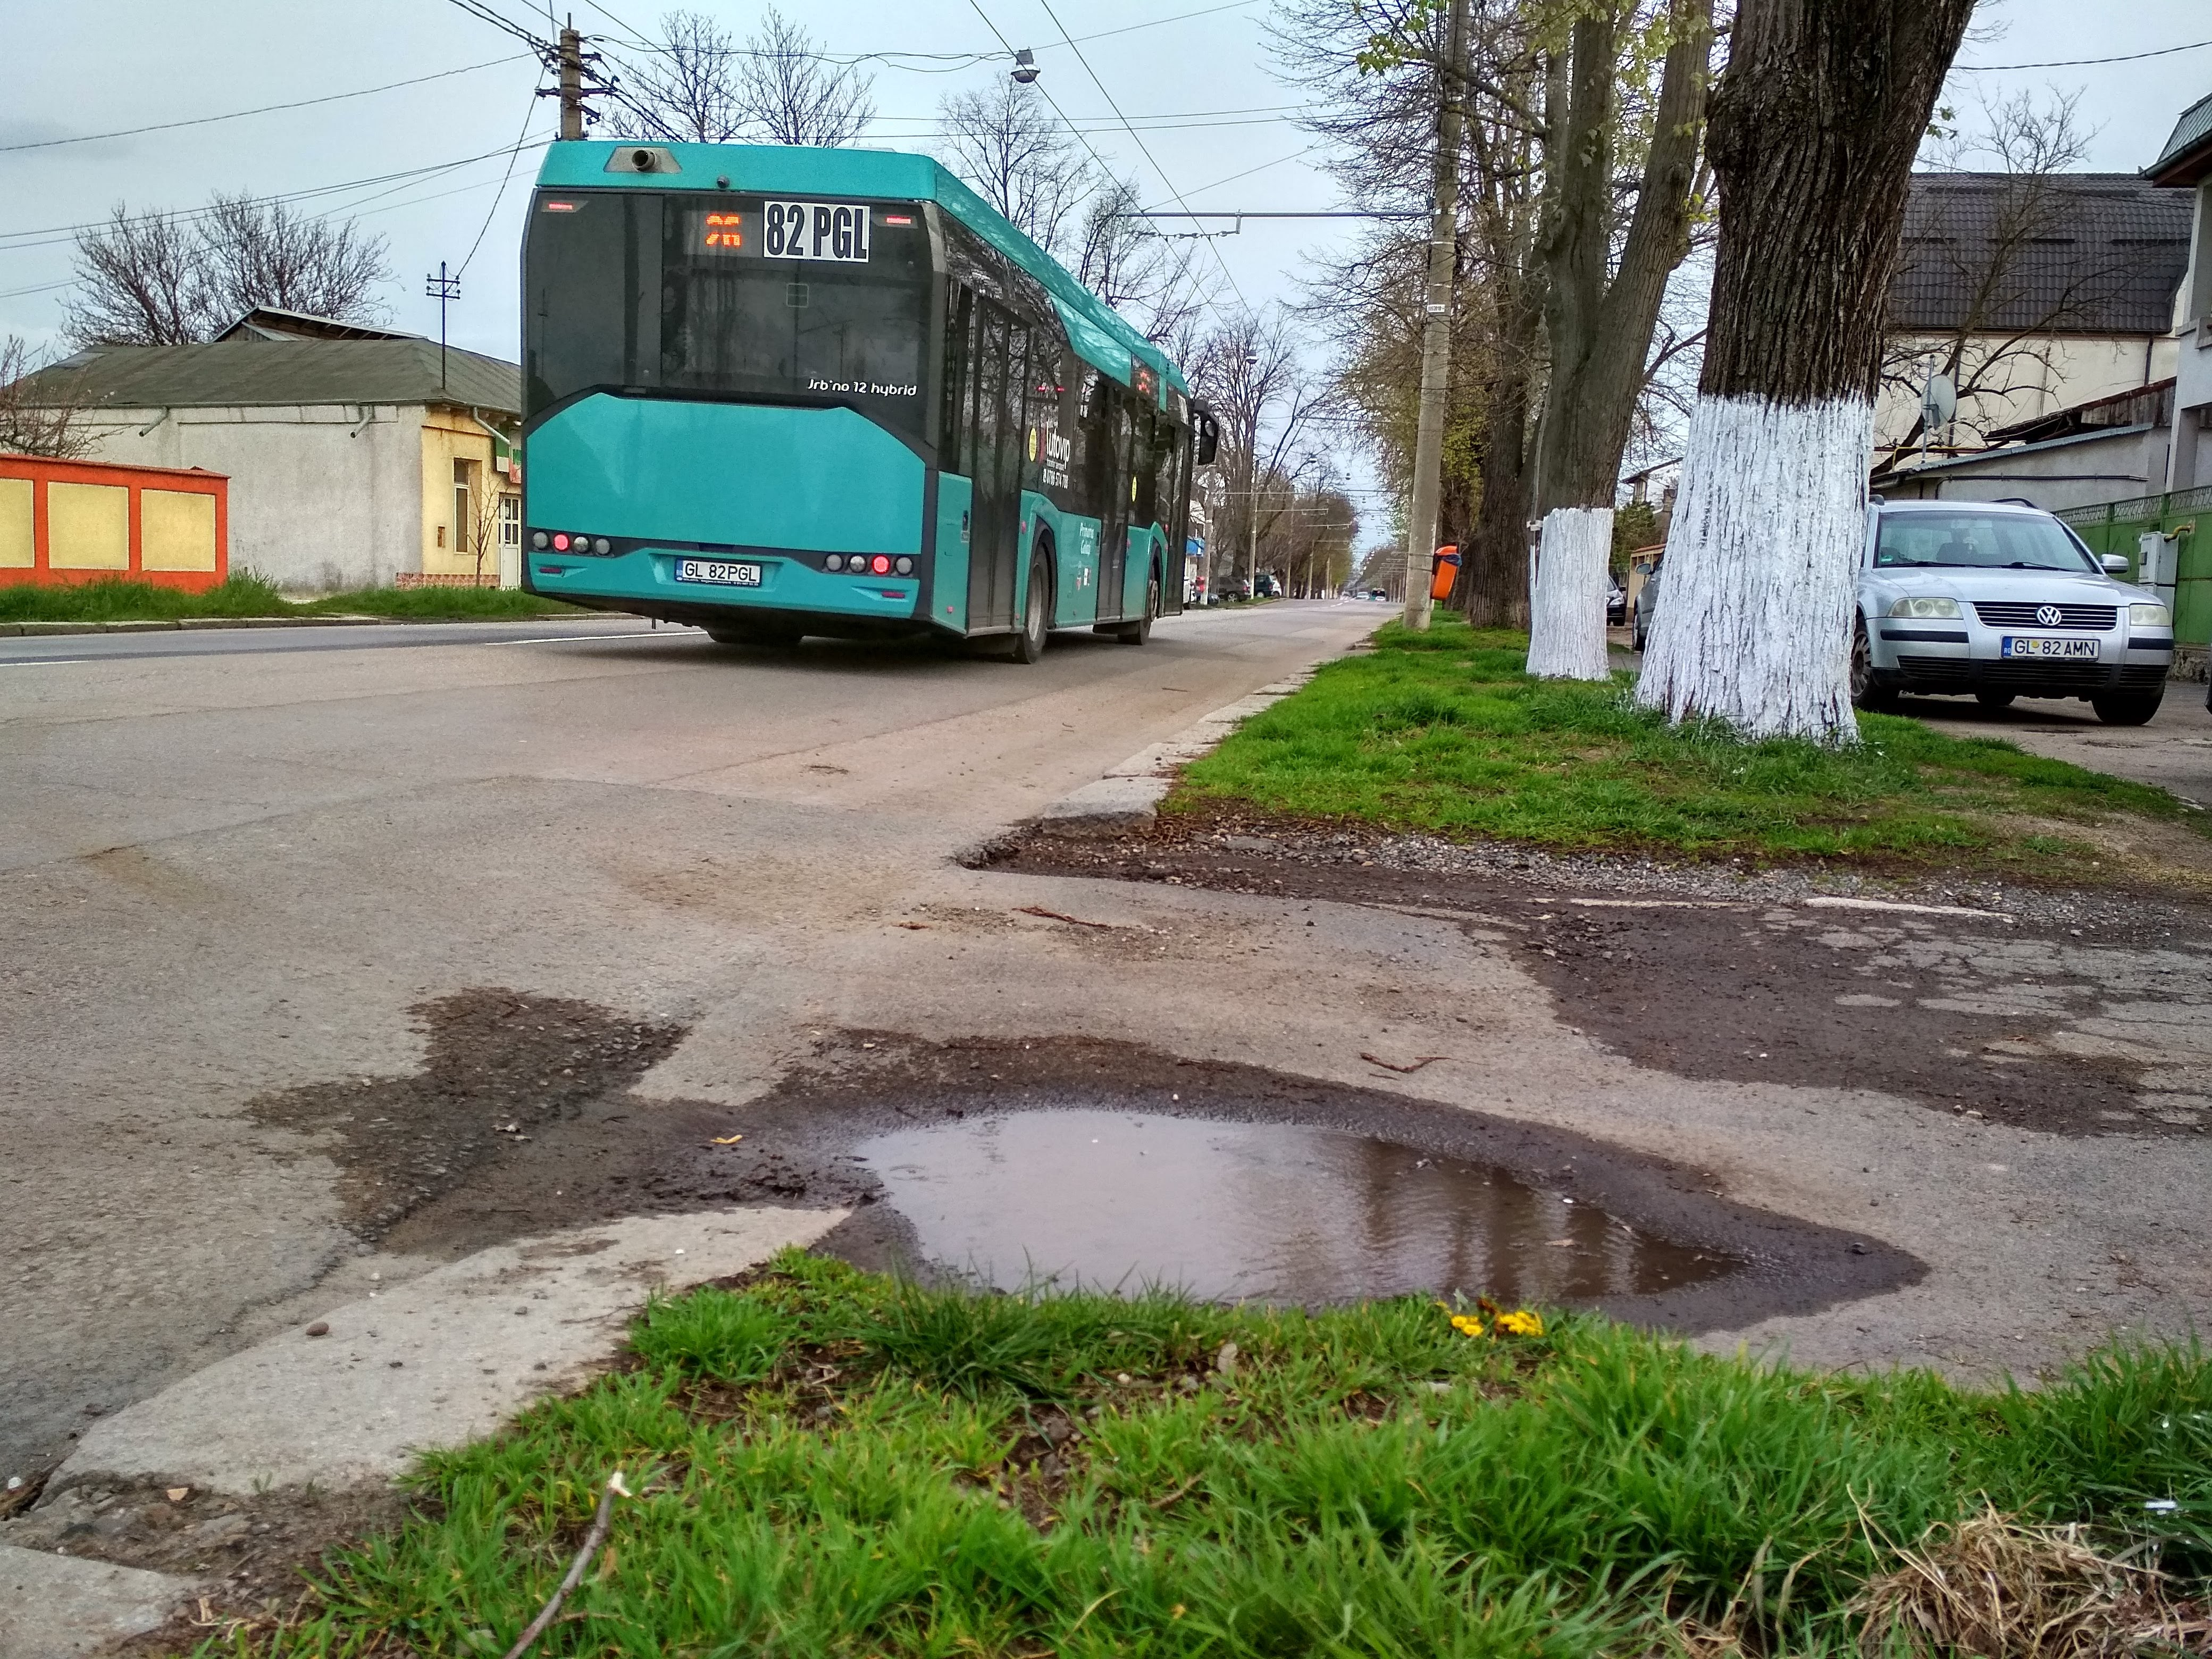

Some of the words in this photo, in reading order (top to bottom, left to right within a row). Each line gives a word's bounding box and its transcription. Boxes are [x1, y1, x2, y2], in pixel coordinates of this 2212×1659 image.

[766, 203, 805, 256] 82
[812, 206, 867, 259] PGL
[853, 381, 867, 394] 12
[870, 382, 917, 397] hybrid
[685, 563, 703, 577] GL
[2014, 640, 2035, 655] GL
